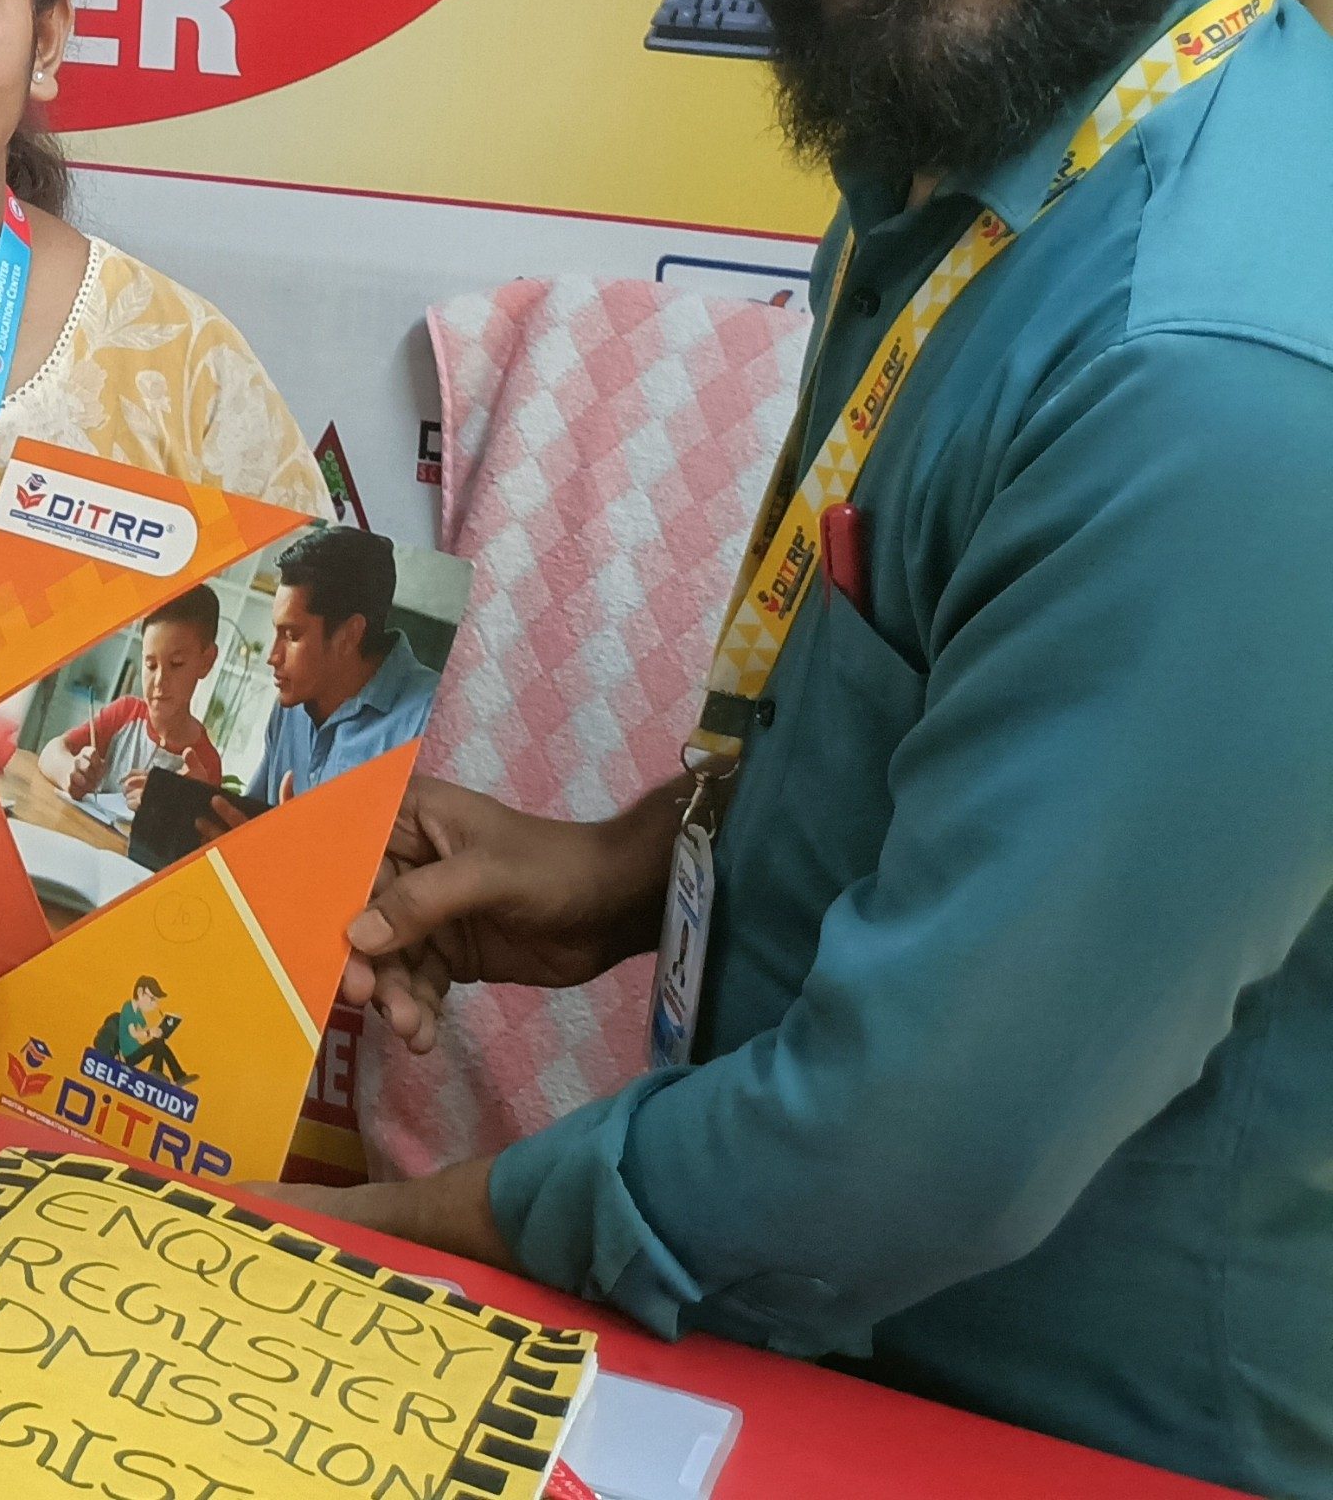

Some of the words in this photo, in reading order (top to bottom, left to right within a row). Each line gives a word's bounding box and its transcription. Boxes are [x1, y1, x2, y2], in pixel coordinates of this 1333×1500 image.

[6, 262, 23, 302] CENTER
[46, 493, 164, 544] DiTRP
[83, 1057, 195, 1121] SELF-STUDY
[55, 1076, 232, 1177] DiTRP
[35, 1190, 495, 1380] ENQUIRY
